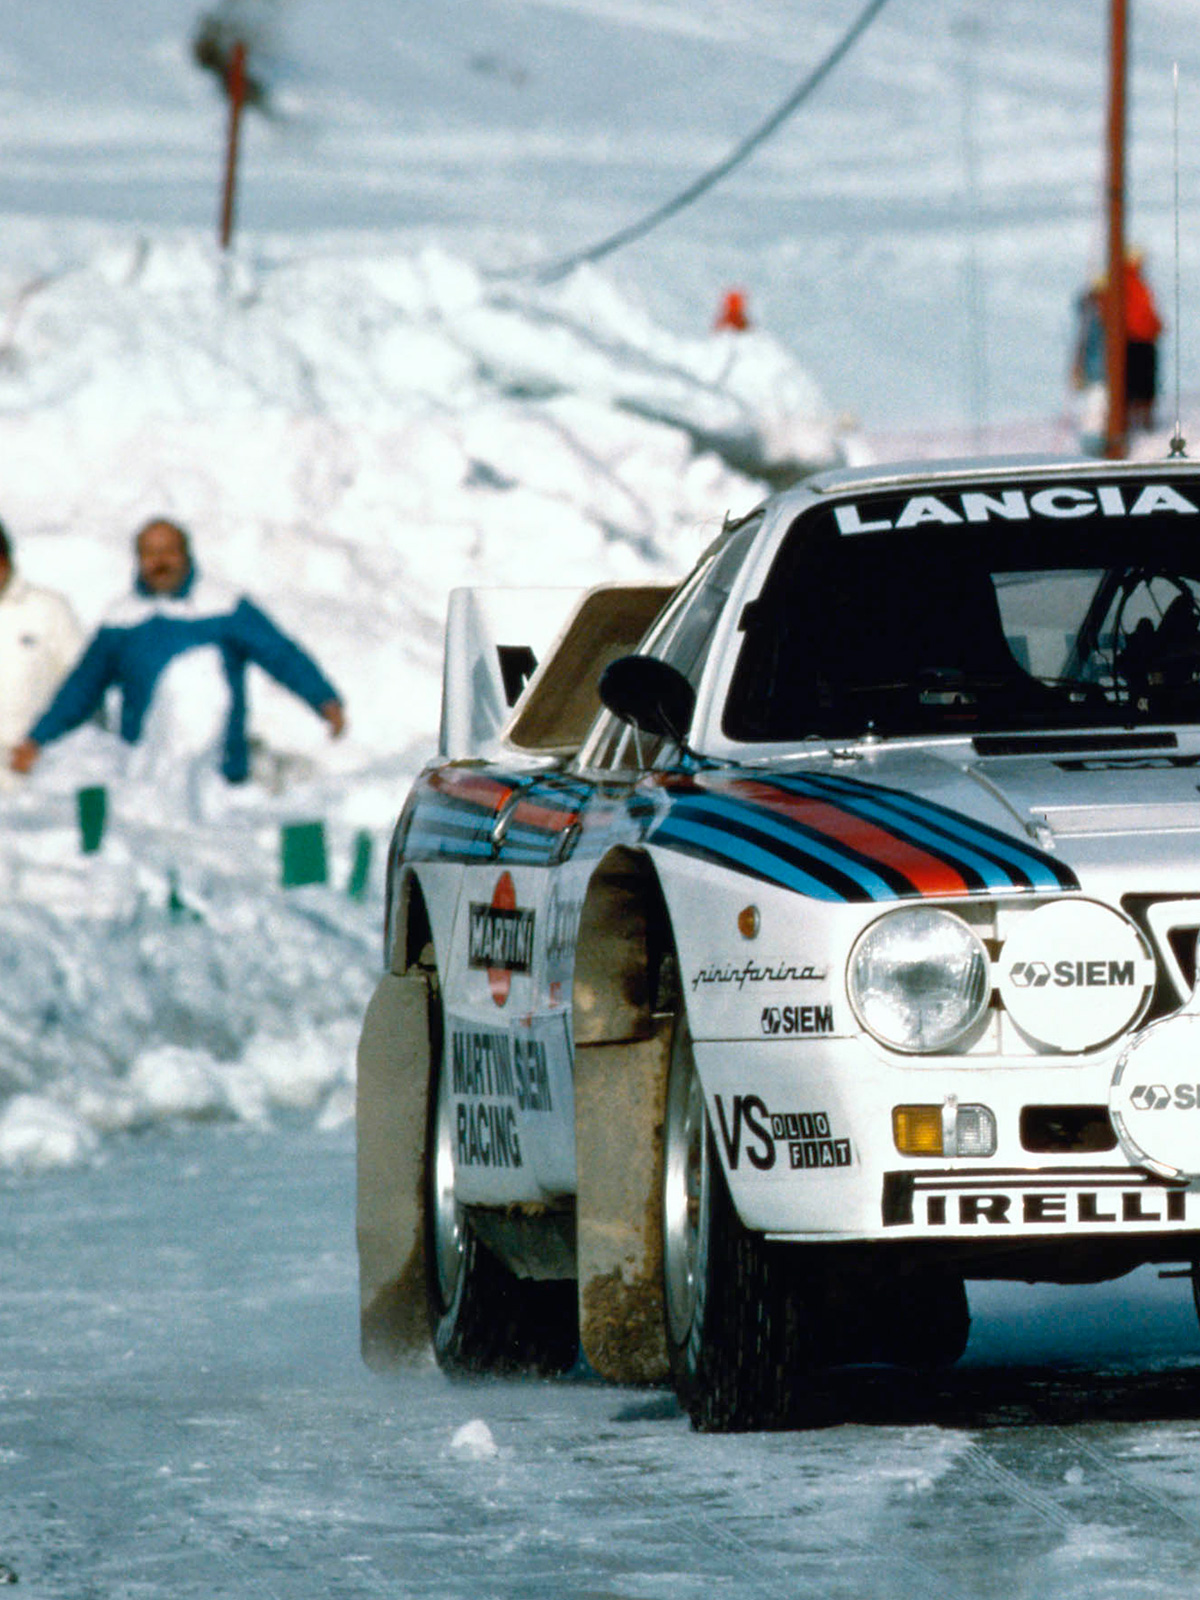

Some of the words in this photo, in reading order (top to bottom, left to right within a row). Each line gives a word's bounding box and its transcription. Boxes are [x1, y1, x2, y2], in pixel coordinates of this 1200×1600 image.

[834, 485, 1200, 536] LANCIA
[472, 912, 533, 964] MARTINI
[692, 960, 827, 991] pininfarina
[1053, 961, 1135, 986] SIEM
[782, 1005, 834, 1033] SIEM
[453, 1032, 514, 1095] MARTINI
[457, 1102, 523, 1167] RACING
[714, 1093, 776, 1171] VS
[772, 1113, 829, 1138] OLIO
[790, 1141, 850, 1168] FIAT
[882, 1166, 1189, 1227] PIRELLI
